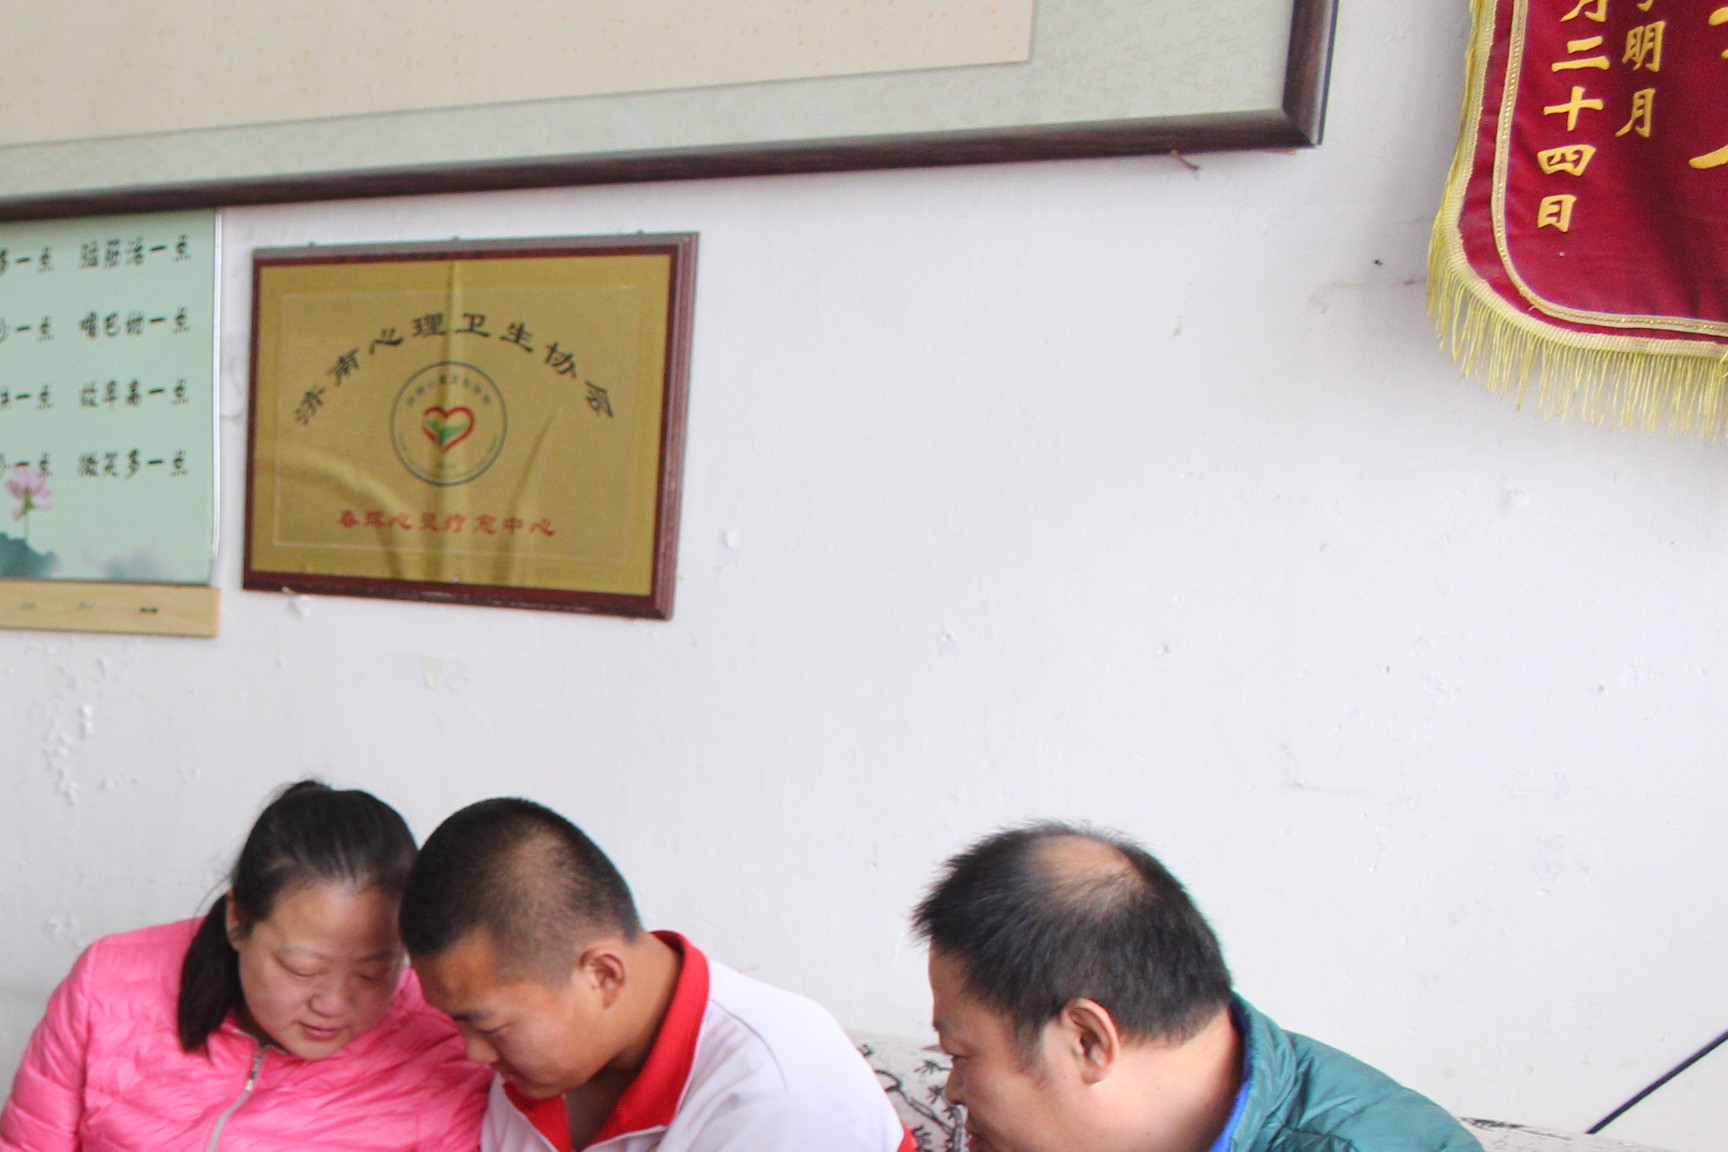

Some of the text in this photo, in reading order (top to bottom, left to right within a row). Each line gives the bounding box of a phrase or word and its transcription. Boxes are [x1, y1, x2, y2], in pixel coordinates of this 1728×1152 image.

[1615, 0, 1666, 138] 明月
[293, 311, 615, 426] 济南心理卫生协会
